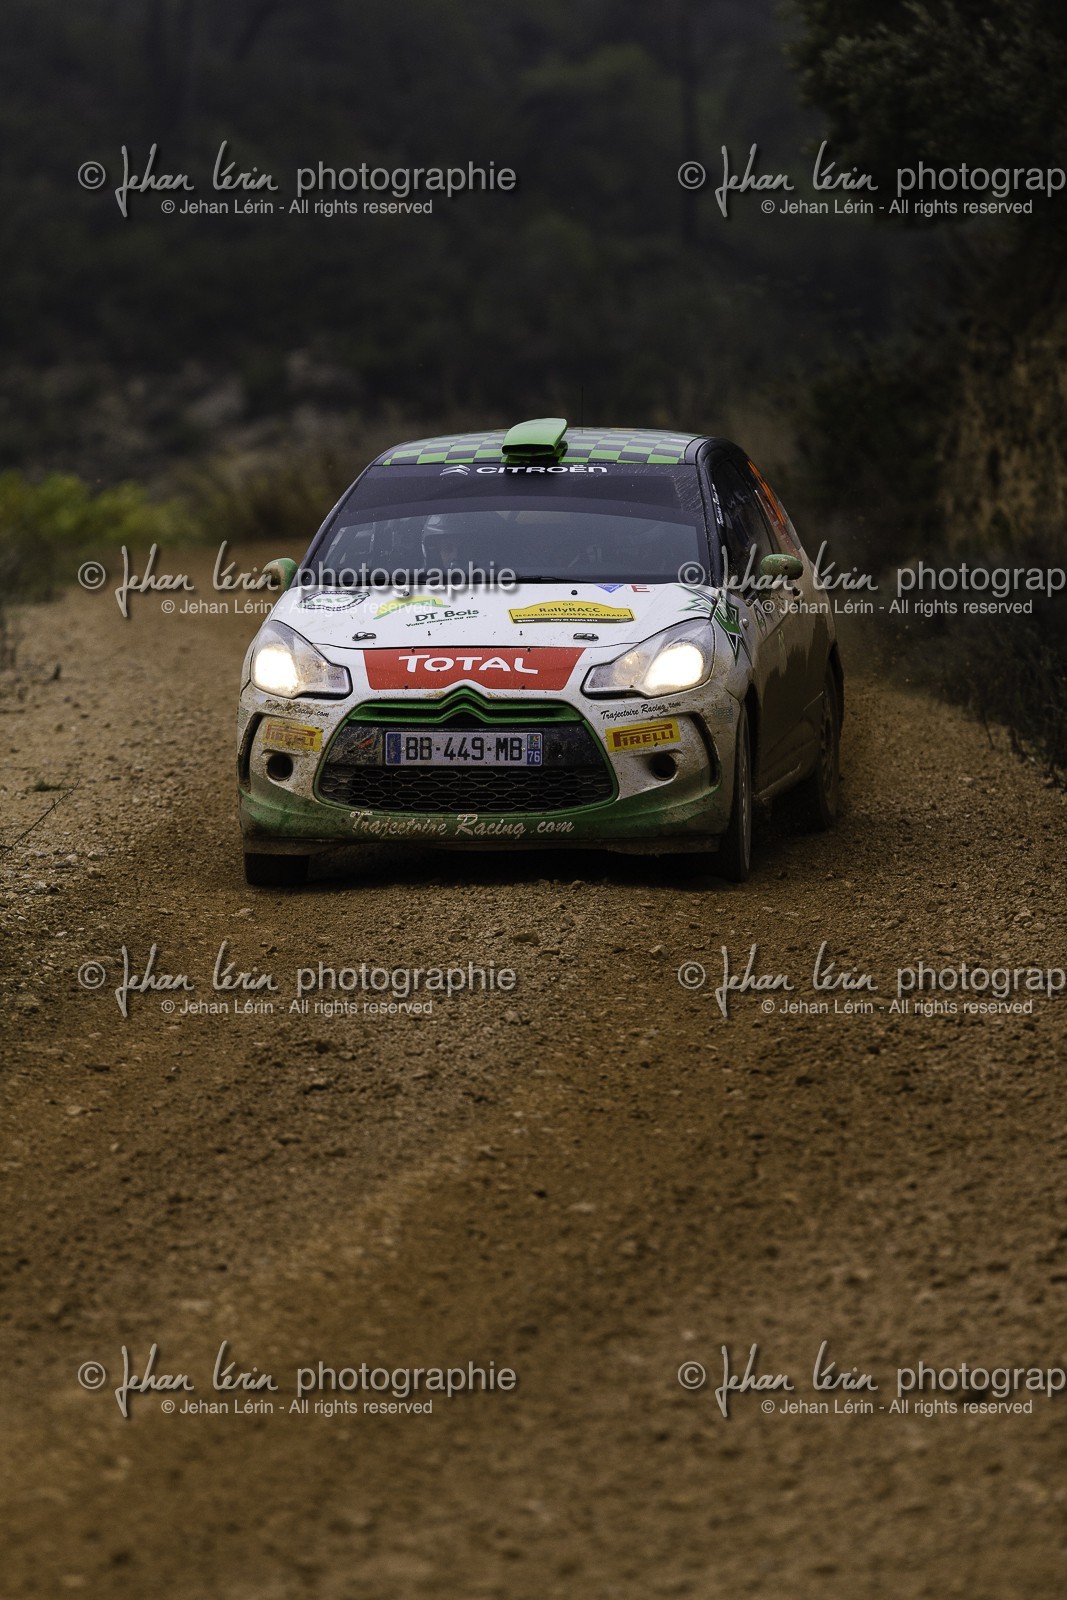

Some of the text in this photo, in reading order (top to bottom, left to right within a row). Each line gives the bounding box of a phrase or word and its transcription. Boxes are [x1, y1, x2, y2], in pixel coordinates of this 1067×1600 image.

[415, 610, 479, 622] DT Bois
[398, 654, 539, 675] TOTAL
[600, 709, 640, 721] Trajectoire
[612, 723, 674, 747] PIRELLI
[527, 751, 541, 763] 76
[455, 813, 527, 839] Racing
